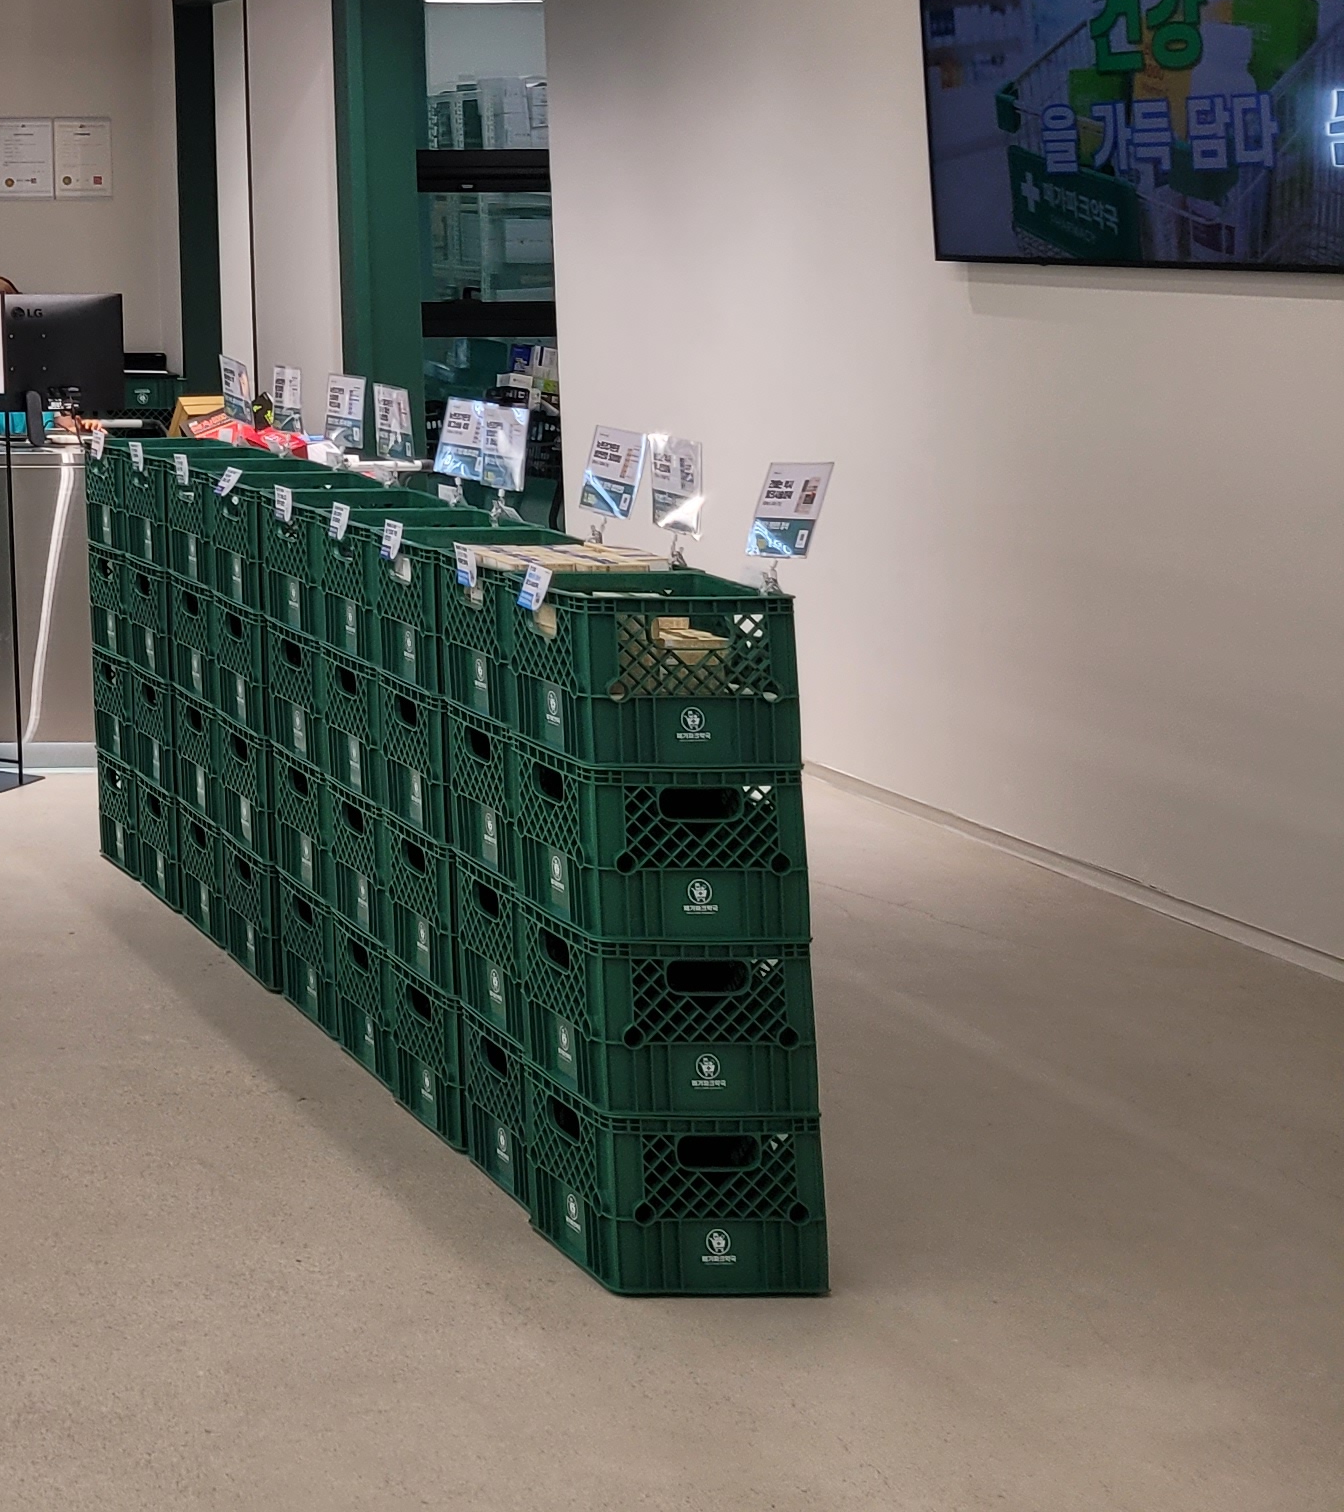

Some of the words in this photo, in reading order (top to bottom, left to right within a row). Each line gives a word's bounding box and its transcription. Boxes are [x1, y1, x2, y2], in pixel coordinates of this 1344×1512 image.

[1041, 103, 1079, 175] 을
[1091, 99, 1173, 172] 가득
[1186, 92, 1279, 172] 담다
[27, 308, 43, 318] LG
